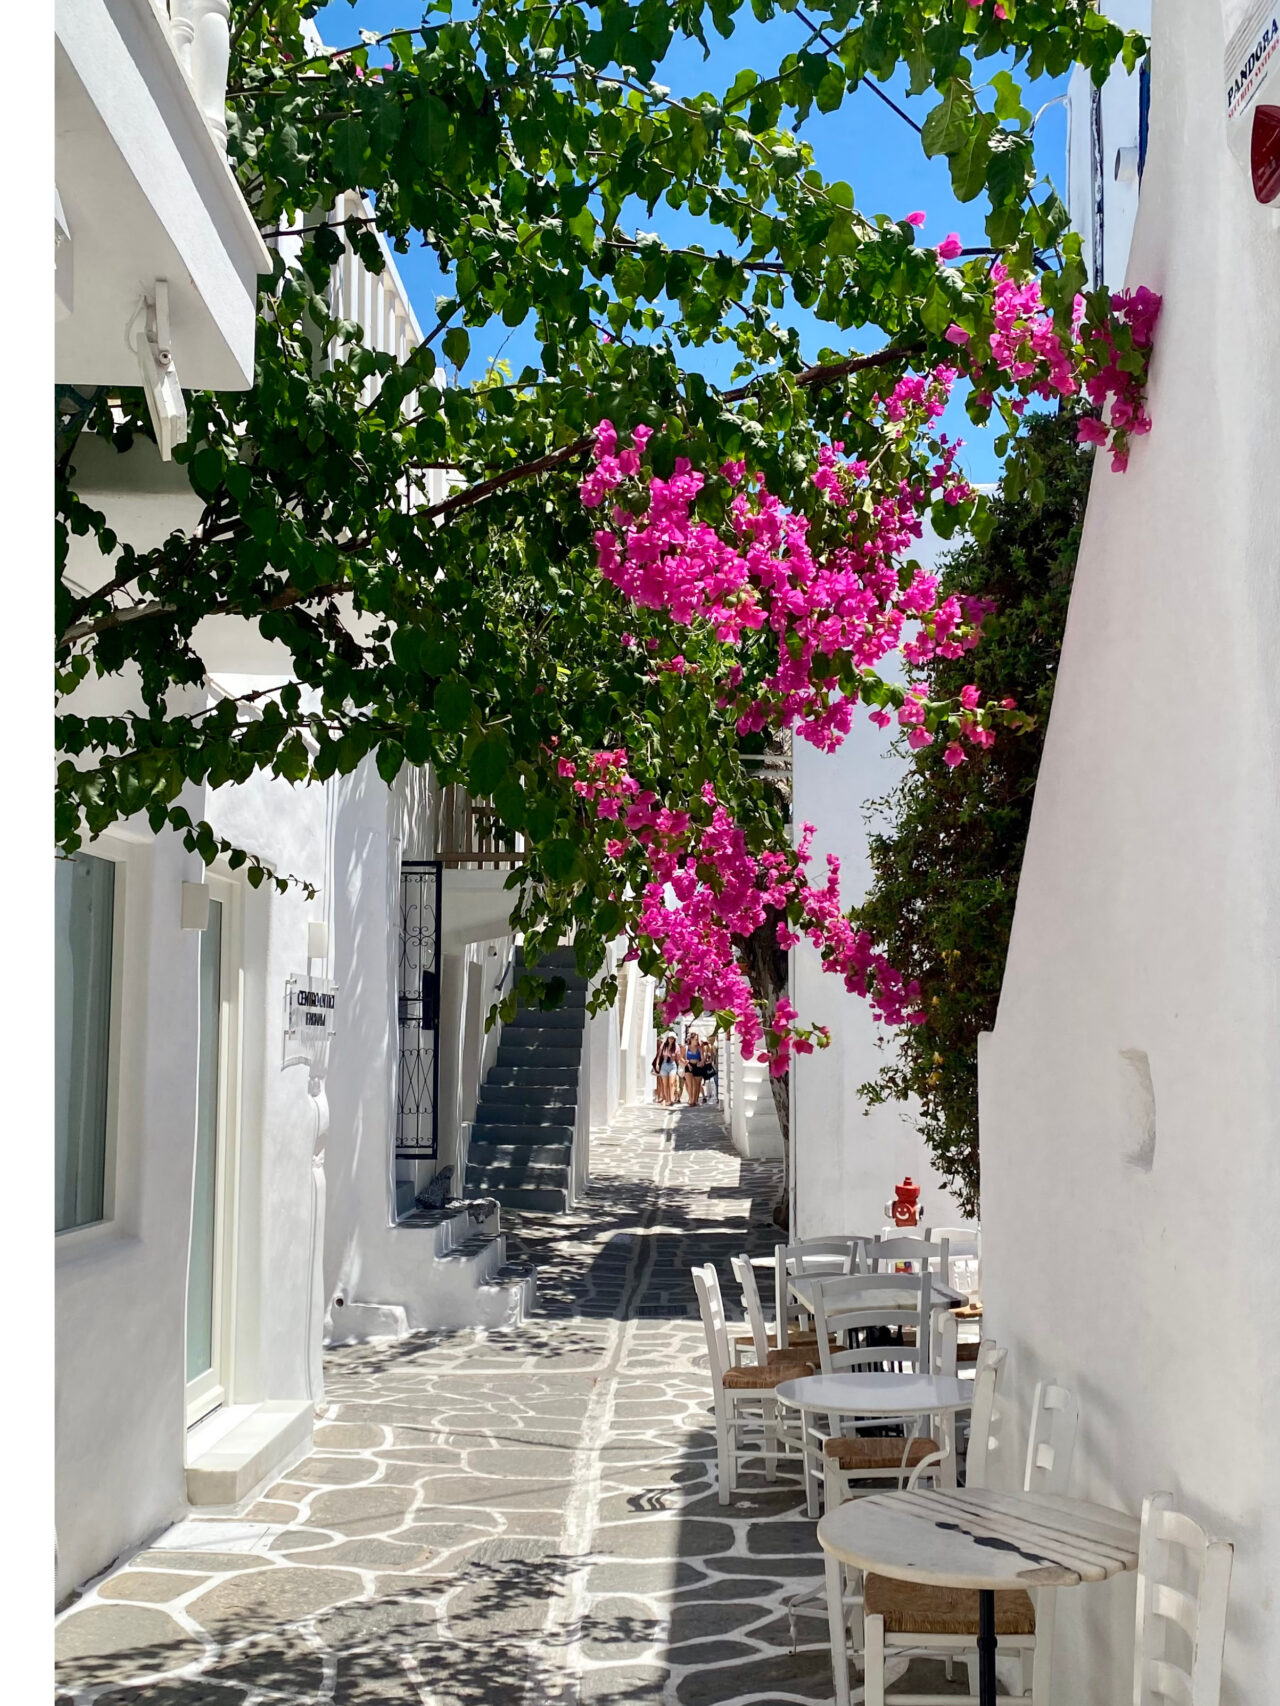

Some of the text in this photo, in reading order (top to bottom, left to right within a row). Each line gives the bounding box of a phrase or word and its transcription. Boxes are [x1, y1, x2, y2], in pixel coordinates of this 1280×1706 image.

[1227, 18, 1279, 109] PANDORA
[1228, 37, 1280, 119] SECURITY SYSTEMS
